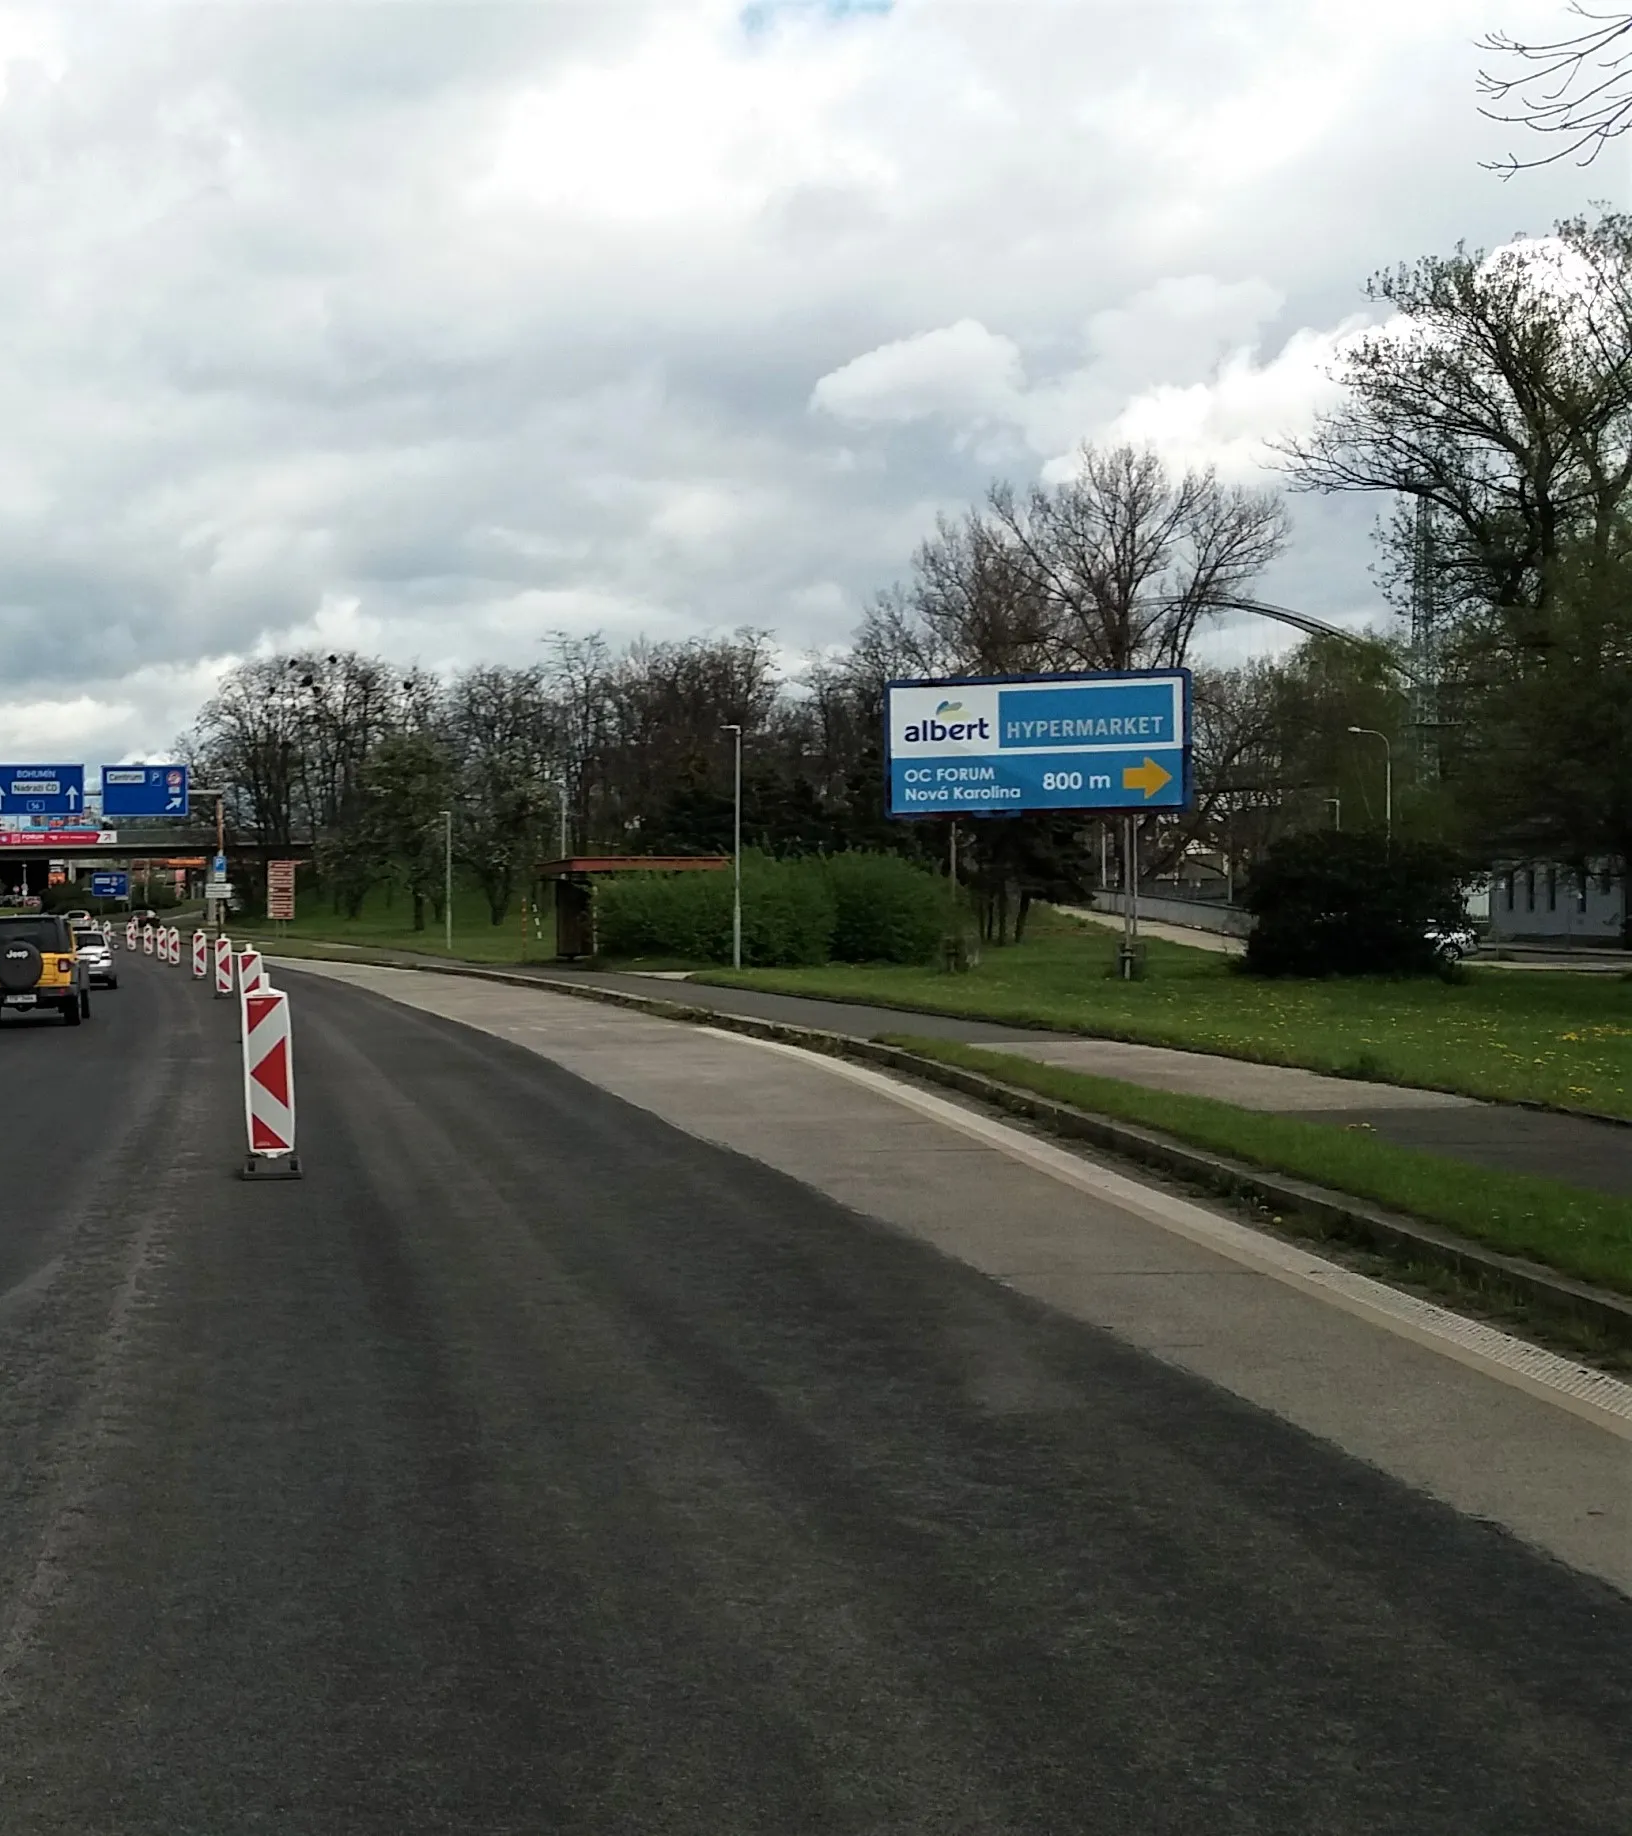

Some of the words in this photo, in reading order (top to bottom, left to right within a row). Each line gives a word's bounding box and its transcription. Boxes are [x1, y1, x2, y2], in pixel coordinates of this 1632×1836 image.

[903, 718, 989, 742] albert
[1006, 716, 1164, 739] HYPERMARKET
[904, 769, 930, 783] OC
[936, 767, 996, 782] FORUM
[1042, 772, 1082, 791] 800
[1089, 774, 1112, 789] m
[904, 785, 949, 802] Nová
[954, 785, 1021, 801] Karolina
[6, 949, 28, 959] Jeep
